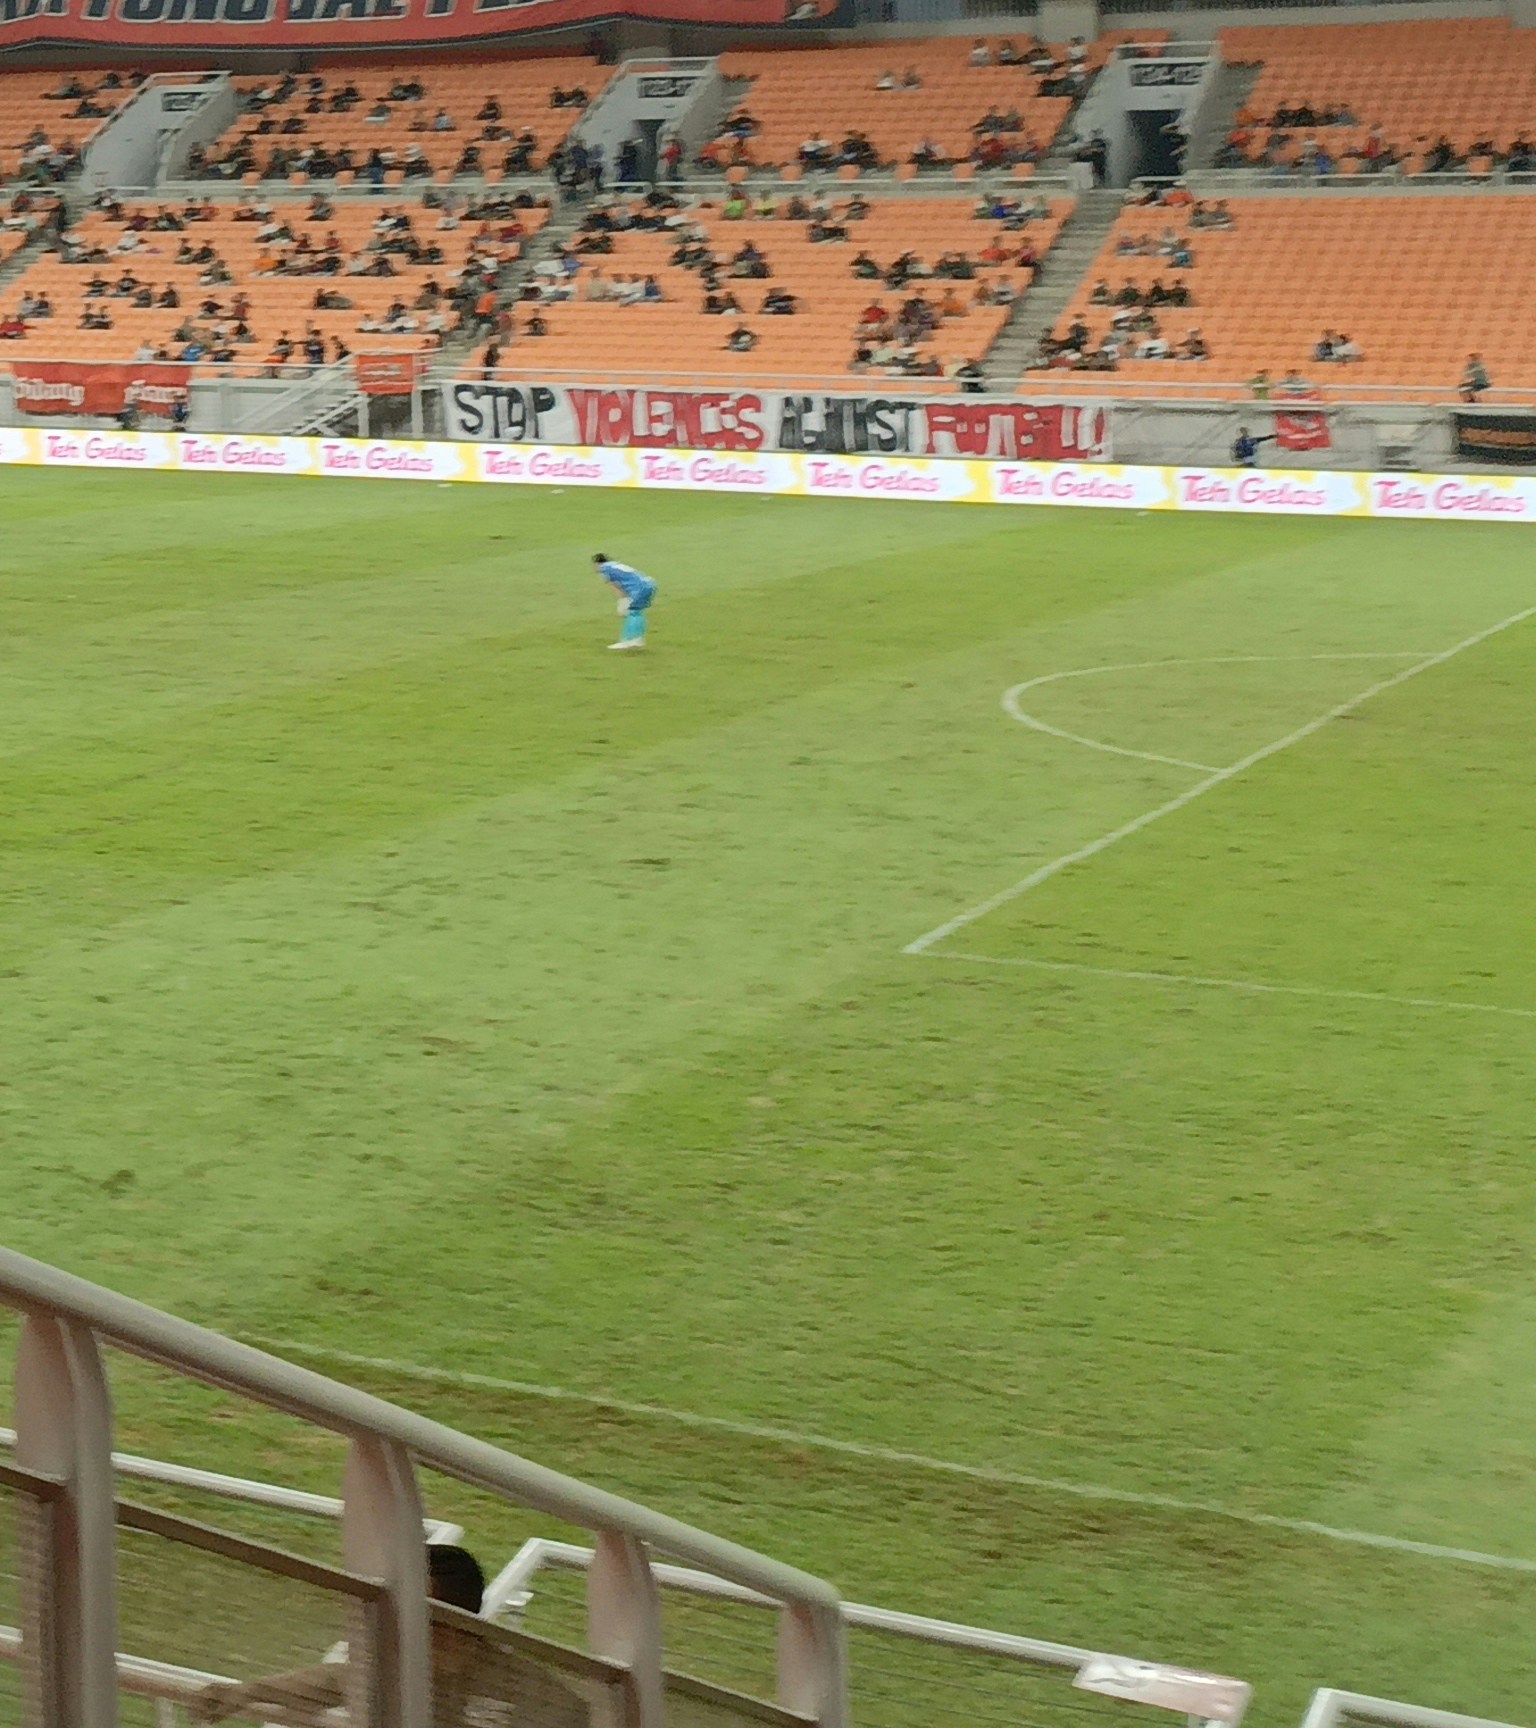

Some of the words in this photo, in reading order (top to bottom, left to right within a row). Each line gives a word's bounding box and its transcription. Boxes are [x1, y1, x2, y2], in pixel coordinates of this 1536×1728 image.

[452, 382, 557, 440] STOP
[46, 435, 81, 461] Teh
[84, 437, 148, 464] Gelas
[181, 439, 218, 466] Teh
[221, 441, 287, 469] Gelas
[321, 444, 361, 471] Teh
[365, 446, 435, 474] Gelas
[481, 449, 526, 478] Teh
[528, 451, 605, 481] Gelas
[641, 454, 685, 483] Teh
[689, 458, 768, 487] Gelas
[806, 461, 855, 490] Teh
[858, 464, 941, 495] Gelas
[997, 468, 1044, 498] Teh
[1049, 471, 1134, 502] Gelas
[1180, 475, 1232, 505] Teh
[1236, 477, 1327, 509] Gelas
[1374, 480, 1428, 512] Teh
[1431, 483, 1526, 515] Gelas
